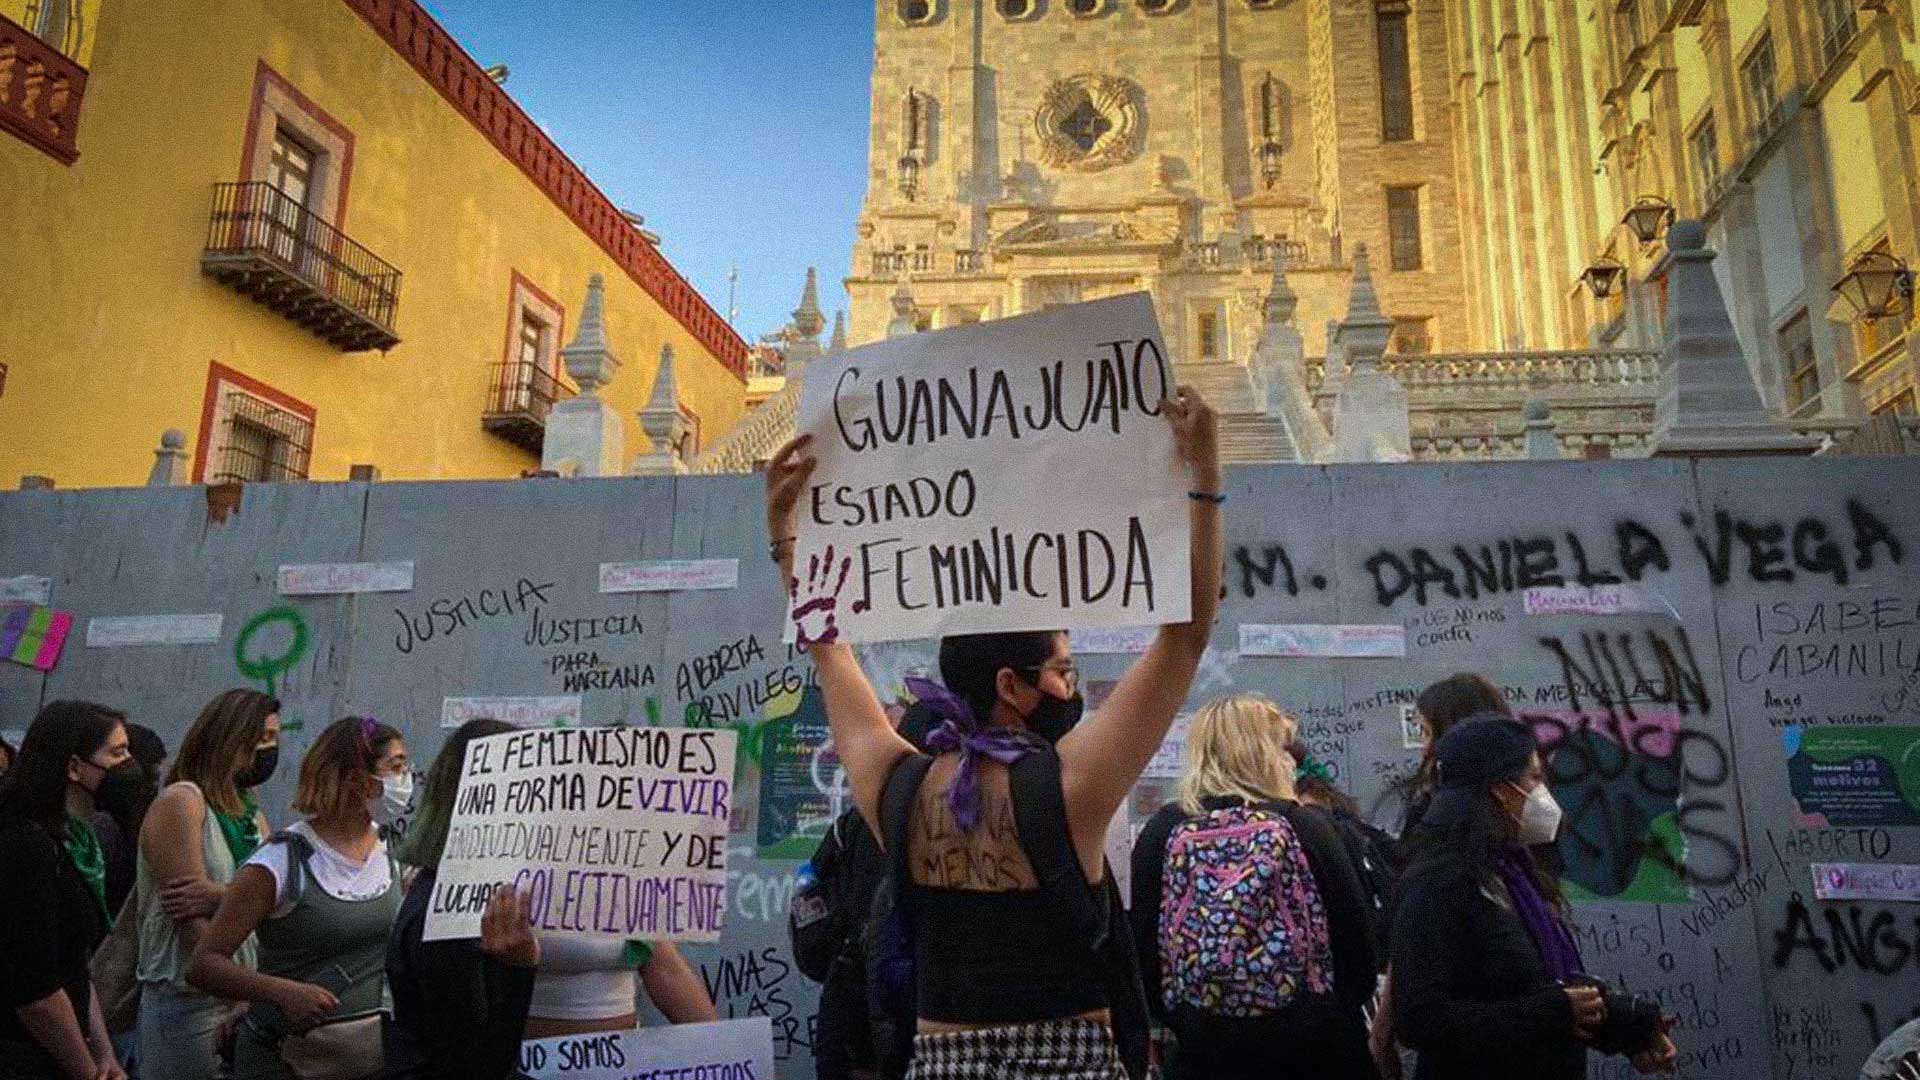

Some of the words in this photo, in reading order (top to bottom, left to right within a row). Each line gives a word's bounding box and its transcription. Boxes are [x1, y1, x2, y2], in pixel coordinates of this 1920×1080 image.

[833, 338, 1168, 452] GUANAJUATO
[811, 470, 976, 527] ESTADO
[856, 516, 1154, 612] FEMINICIDA
[1364, 518, 1671, 606] DANIELA
[1682, 496, 1904, 586] VEGA
[395, 577, 555, 653] JUSTICIA
[525, 607, 643, 647] JUSTICIA
[1756, 597, 1920, 642] ISABE
[551, 651, 599, 676] PARA
[563, 664, 656, 692] MARIANA
[676, 634, 765, 701] ABORTA
[1737, 638, 1920, 684] CABANIL
[469, 743, 492, 777] EL
[503, 730, 670, 773] FEMINISMO
[678, 731, 717, 775] ES
[457, 783, 496, 816] UNA
[504, 774, 586, 813] FORMA
[447, 820, 651, 870] INDIVIDUALMENTE
[660, 831, 683, 867] Y
[687, 834, 727, 870] DE
[1785, 827, 1891, 860] ABORTO
[512, 867, 727, 935] COLECTIVAMENTE
[558, 1034, 625, 1071] SOMOS
